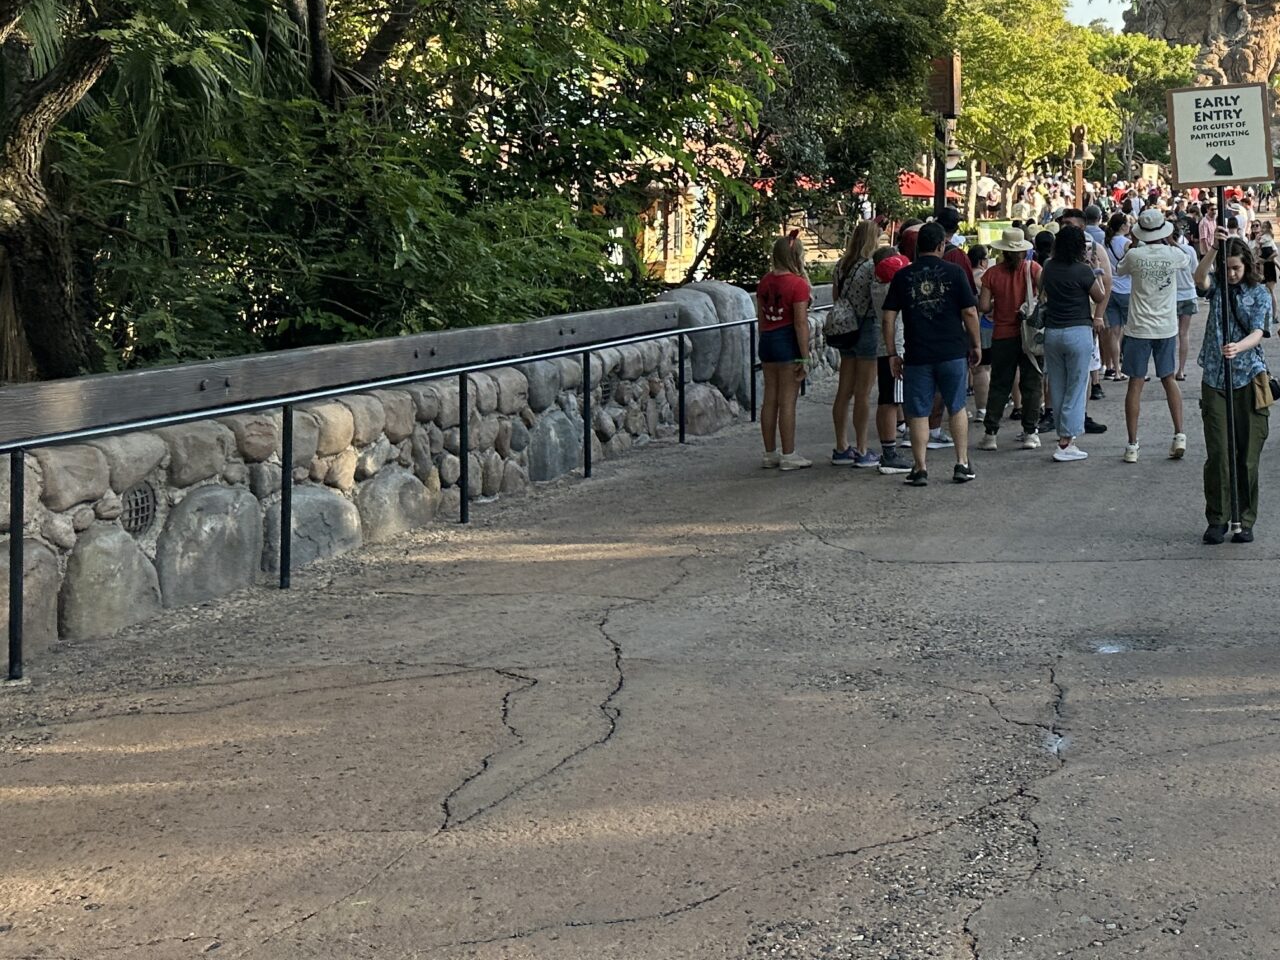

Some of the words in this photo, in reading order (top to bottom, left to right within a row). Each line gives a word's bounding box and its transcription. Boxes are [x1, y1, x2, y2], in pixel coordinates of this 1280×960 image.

[1194, 95, 1241, 109] EARLY
[1194, 108, 1243, 123] ENTRY
[1192, 123, 1209, 132] FOR
[1210, 122, 1234, 131] GUEST
[1190, 130, 1250, 141] PARTICIPATING
[1205, 139, 1236, 148] HOTELS
